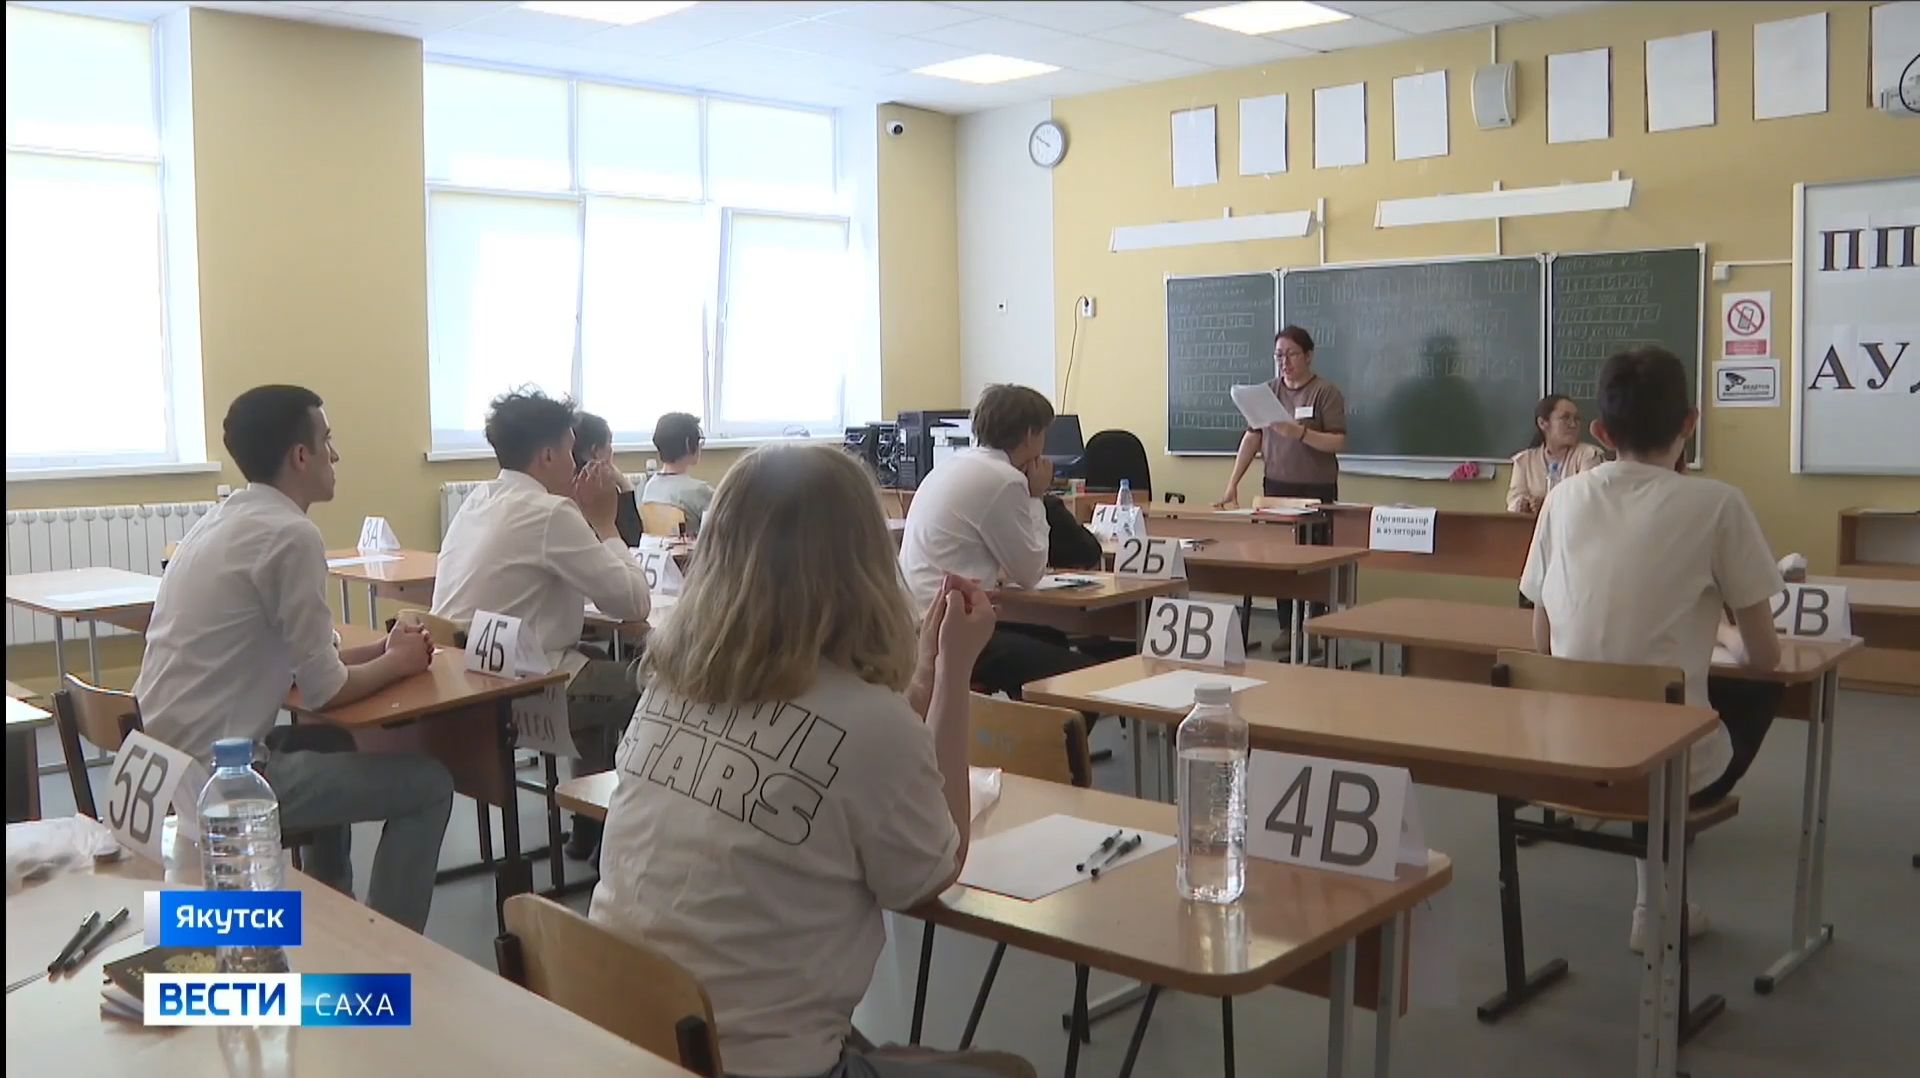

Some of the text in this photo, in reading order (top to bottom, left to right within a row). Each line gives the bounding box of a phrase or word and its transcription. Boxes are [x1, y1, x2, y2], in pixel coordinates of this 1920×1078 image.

[1808, 342, 1920, 393] АУ
[363, 519, 379, 549] 3А
[1376, 514, 1429, 526] Организатор
[1383, 528, 1427, 537] аудитории
[1120, 538, 1166, 574] 2Б
[1150, 603, 1214, 660] 3В
[1773, 588, 1829, 636] 2В
[476, 619, 508, 673] 4Б
[634, 688, 847, 789] AWL
[109, 744, 169, 844] 5В
[1265, 766, 1380, 866] 4В
